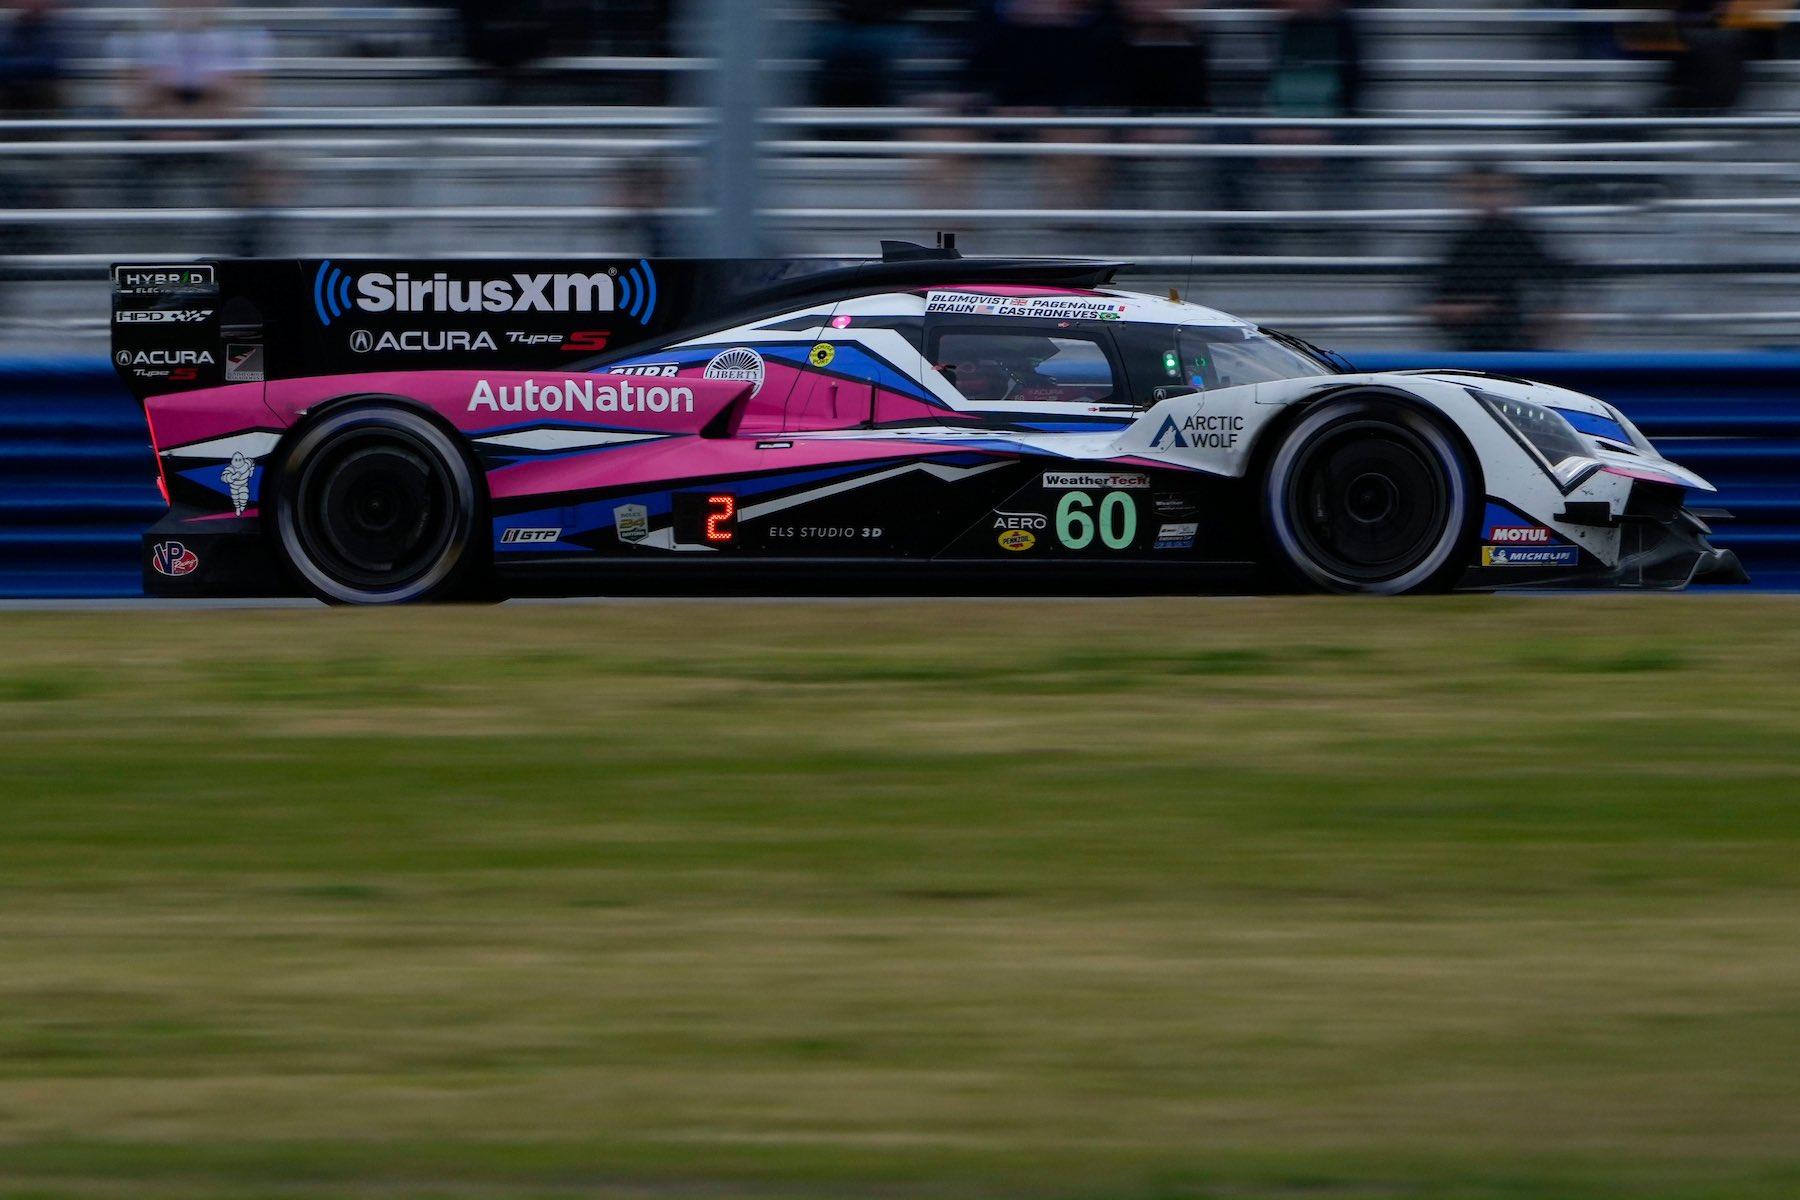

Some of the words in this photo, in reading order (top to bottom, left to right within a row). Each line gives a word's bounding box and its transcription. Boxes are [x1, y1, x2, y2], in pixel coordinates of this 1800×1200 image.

[931, 294, 1010, 306] BLOMQVIST
[1032, 299, 1107, 311] PAGENAUD
[927, 303, 976, 313] BRAUN
[998, 306, 1099, 319] CASTRONEVES
[119, 311, 164, 321] HPD
[375, 331, 498, 351] ACURA
[505, 331, 563, 345] Type
[560, 330, 611, 351] S
[133, 350, 215, 365] ACURA
[133, 368, 170, 378] Type
[167, 368, 199, 380] S
[709, 369, 760, 379] LIBERTY
[467, 379, 694, 413] AutoNation
[1184, 415, 1244, 431] ARCTIC
[1191, 433, 1239, 448] WOLF
[1046, 475, 1148, 485] WeatherTech
[705, 495, 734, 540] 2
[993, 517, 1048, 529] AERO
[1056, 490, 1137, 550] 60
[519, 530, 557, 541] GTP
[769, 526, 796, 538] ELS
[800, 526, 854, 538] STUDIO
[861, 526, 883, 538] 3D
[1492, 528, 1548, 541] MOTUL
[153, 540, 185, 575] VP
[1510, 552, 1571, 561] MICHELIN
